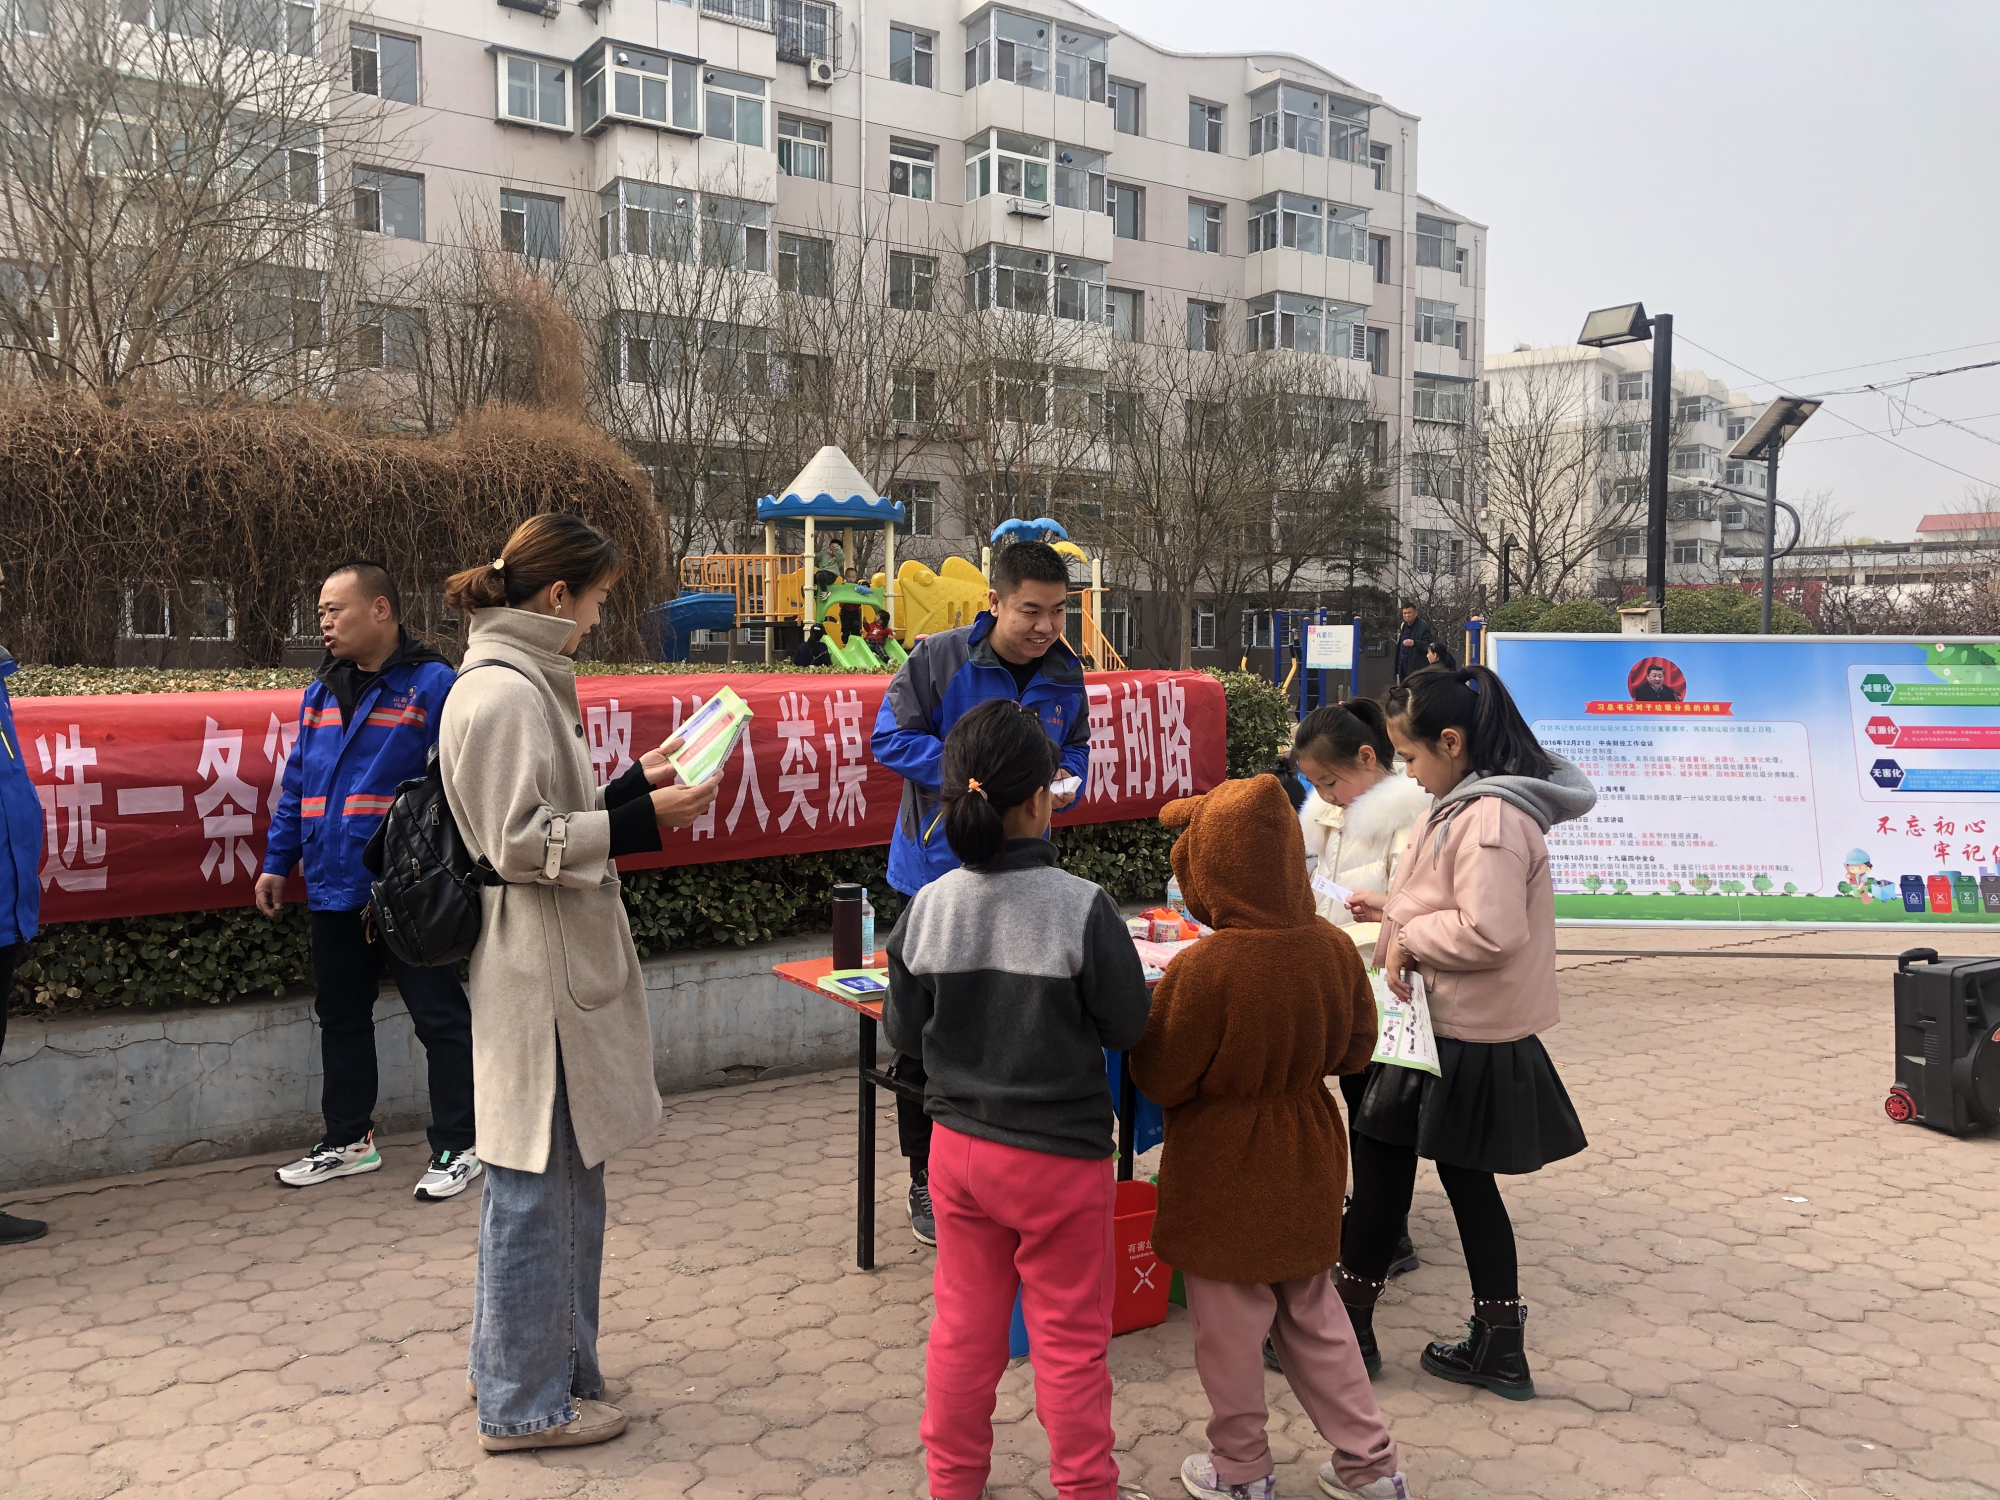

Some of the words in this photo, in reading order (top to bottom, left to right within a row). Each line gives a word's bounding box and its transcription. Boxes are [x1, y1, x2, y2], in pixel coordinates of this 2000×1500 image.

[1863, 684, 1892, 692] 减量化
[1597, 703, 1720, 712] 习总书记对于垃圾分类的讲话
[1867, 725, 1897, 735] 资源化
[1084, 679, 1193, 804] 展的路
[1872, 768, 1902, 778] 无害化
[1876, 815, 1986, 837] 不忘初心
